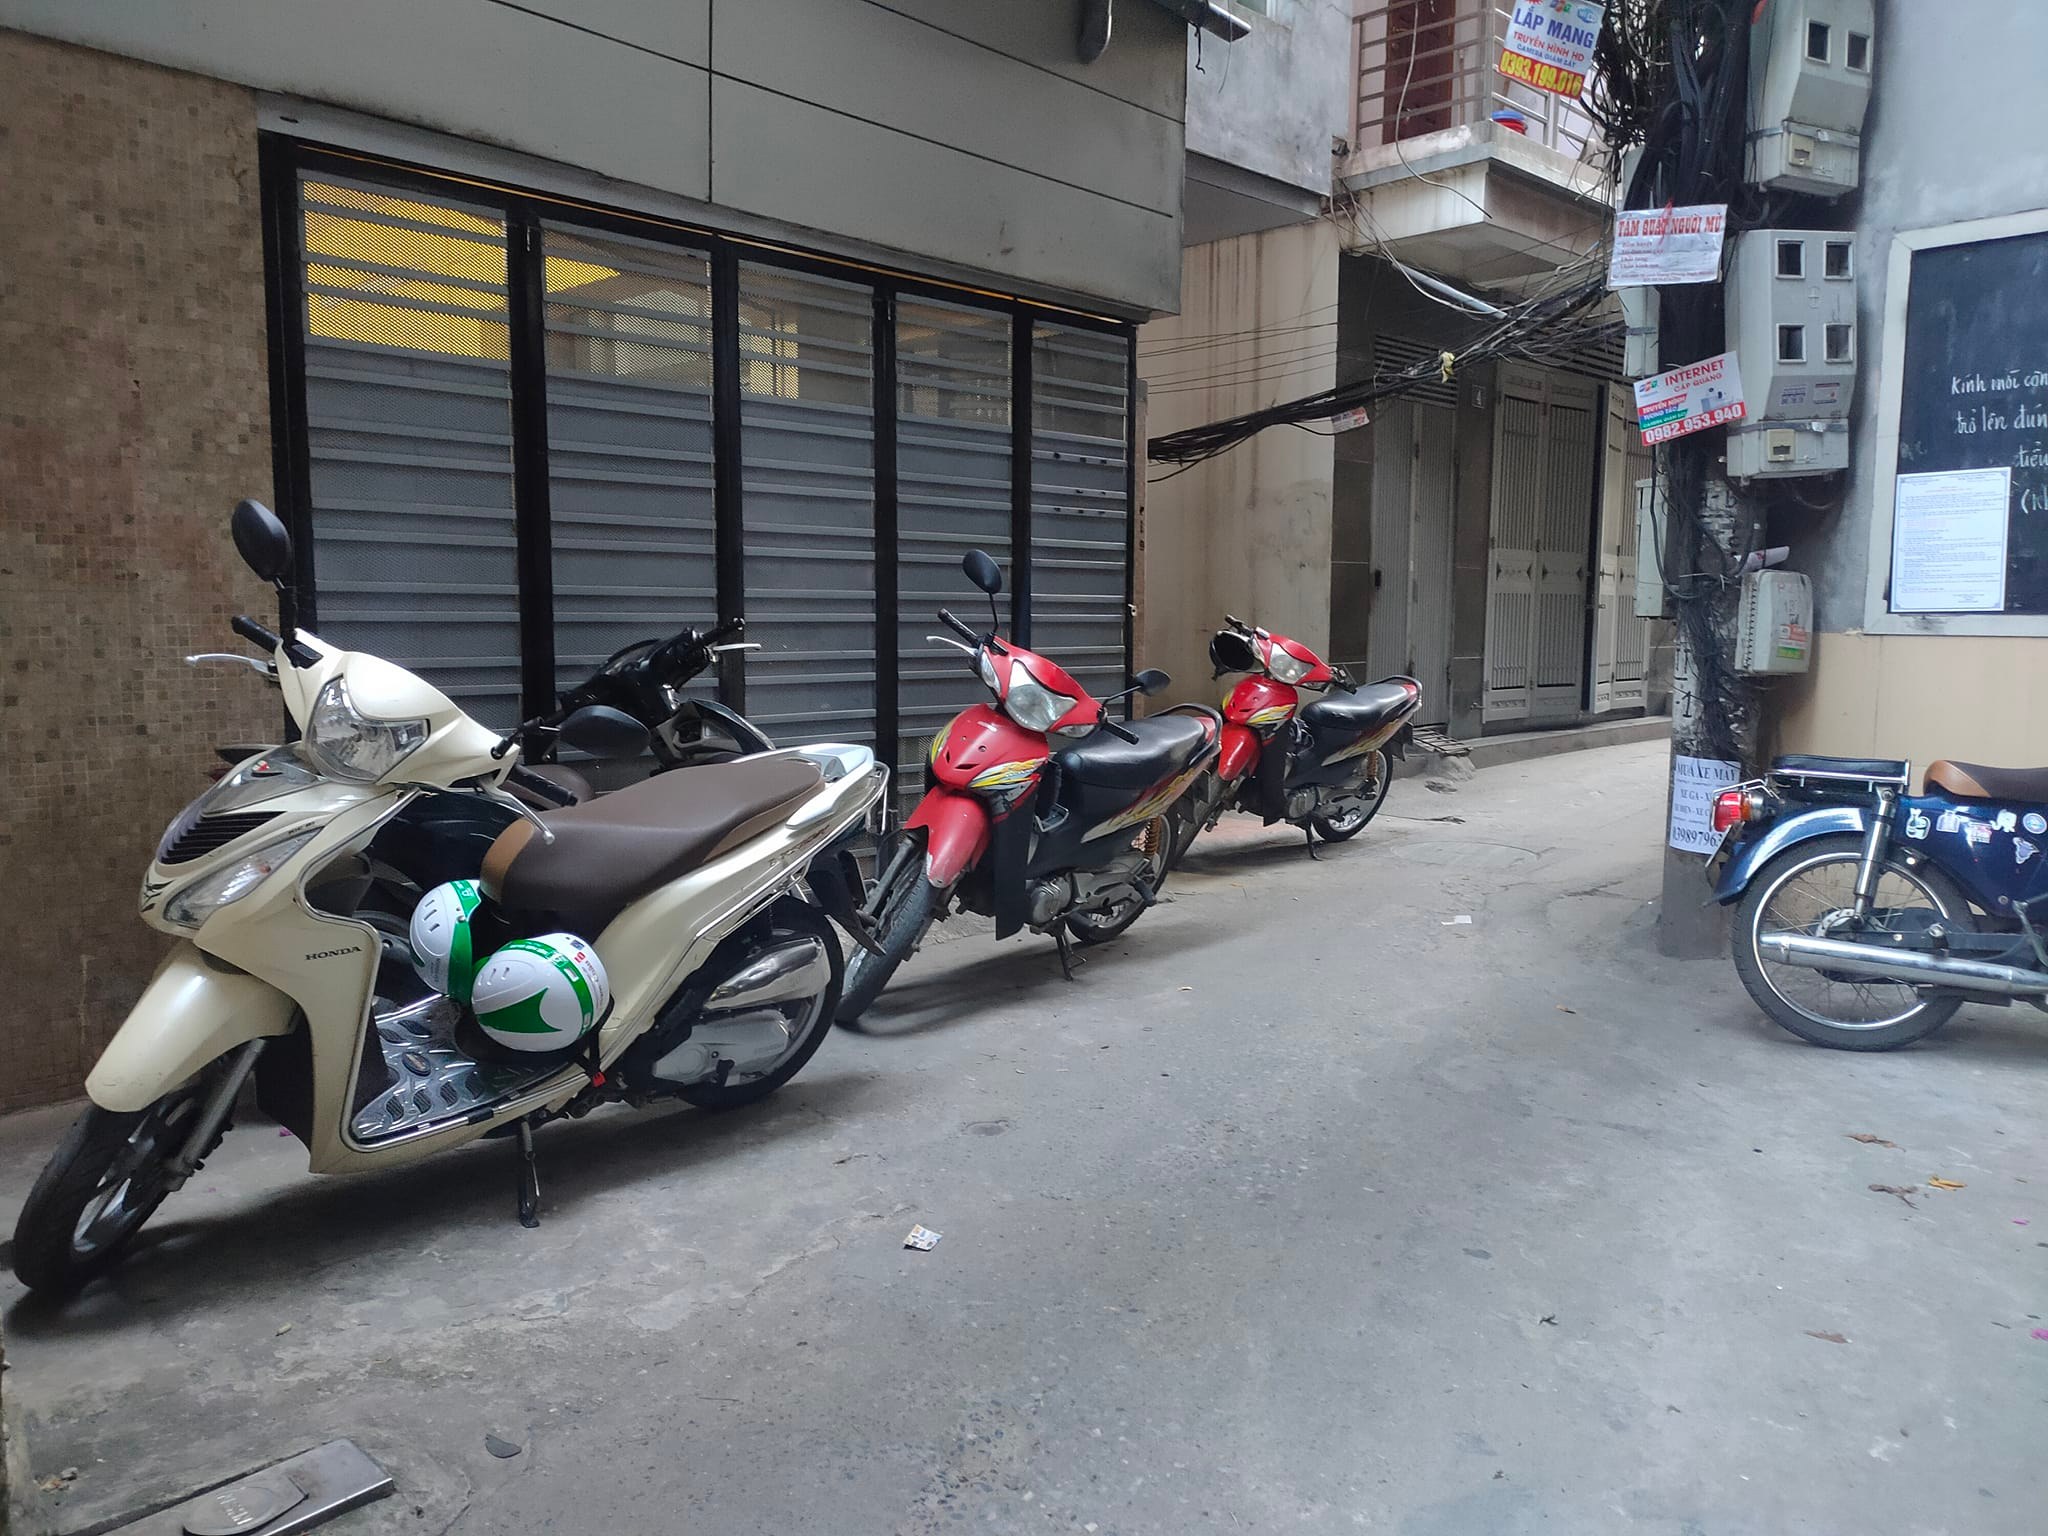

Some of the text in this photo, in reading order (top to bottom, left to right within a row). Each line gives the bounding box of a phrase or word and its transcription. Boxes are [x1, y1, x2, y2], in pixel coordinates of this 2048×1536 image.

[1547, 19, 1594, 49] MẠNG
[1571, 50, 1585, 62] HD
[1665, 359, 1725, 386] INTERNET
[1952, 373, 1987, 395] Kính
[1646, 404, 1742, 443] 0982.953.940
[1982, 405, 2008, 432] lên
[305, 946, 362, 960] HONDA
